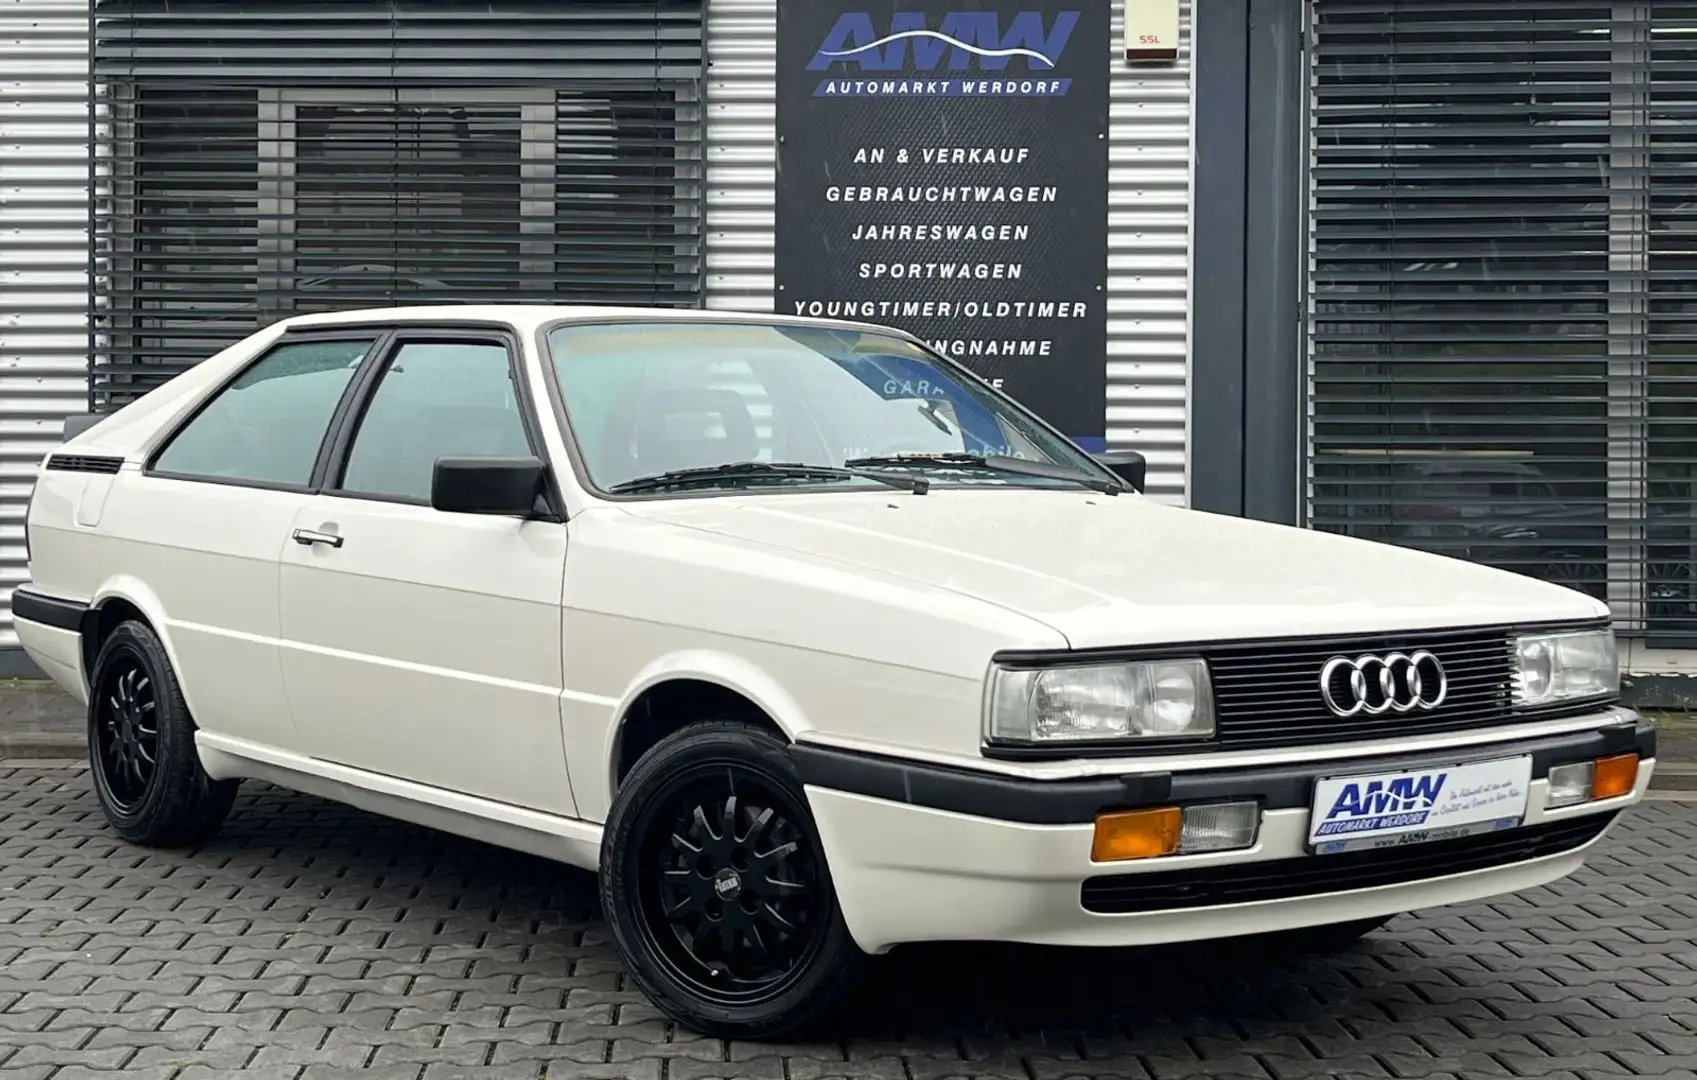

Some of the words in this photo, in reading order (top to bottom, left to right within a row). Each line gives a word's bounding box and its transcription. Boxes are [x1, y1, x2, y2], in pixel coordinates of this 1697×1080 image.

[806, 11, 1081, 71] AMW
[825, 81, 950, 94] AUTOMARKT
[962, 81, 1060, 94] WERDORF
[853, 148, 885, 164] AN
[896, 148, 910, 164] &
[922, 148, 1029, 164] VERKAUF
[826, 186, 1057, 202] GEBRAUCHTWAGEN
[852, 225, 1029, 241] JAHRESWAGEN
[859, 263, 1022, 279] SPORTWAGEN
[794, 301, 1087, 319] YOUNGTIMER/OLDTIMER
[926, 339, 1052, 356] NGNAHME
[1326, 774, 1447, 819] AMW
[1318, 817, 1380, 835] AUTOMARKT
[1379, 811, 1426, 829] WERDORF
